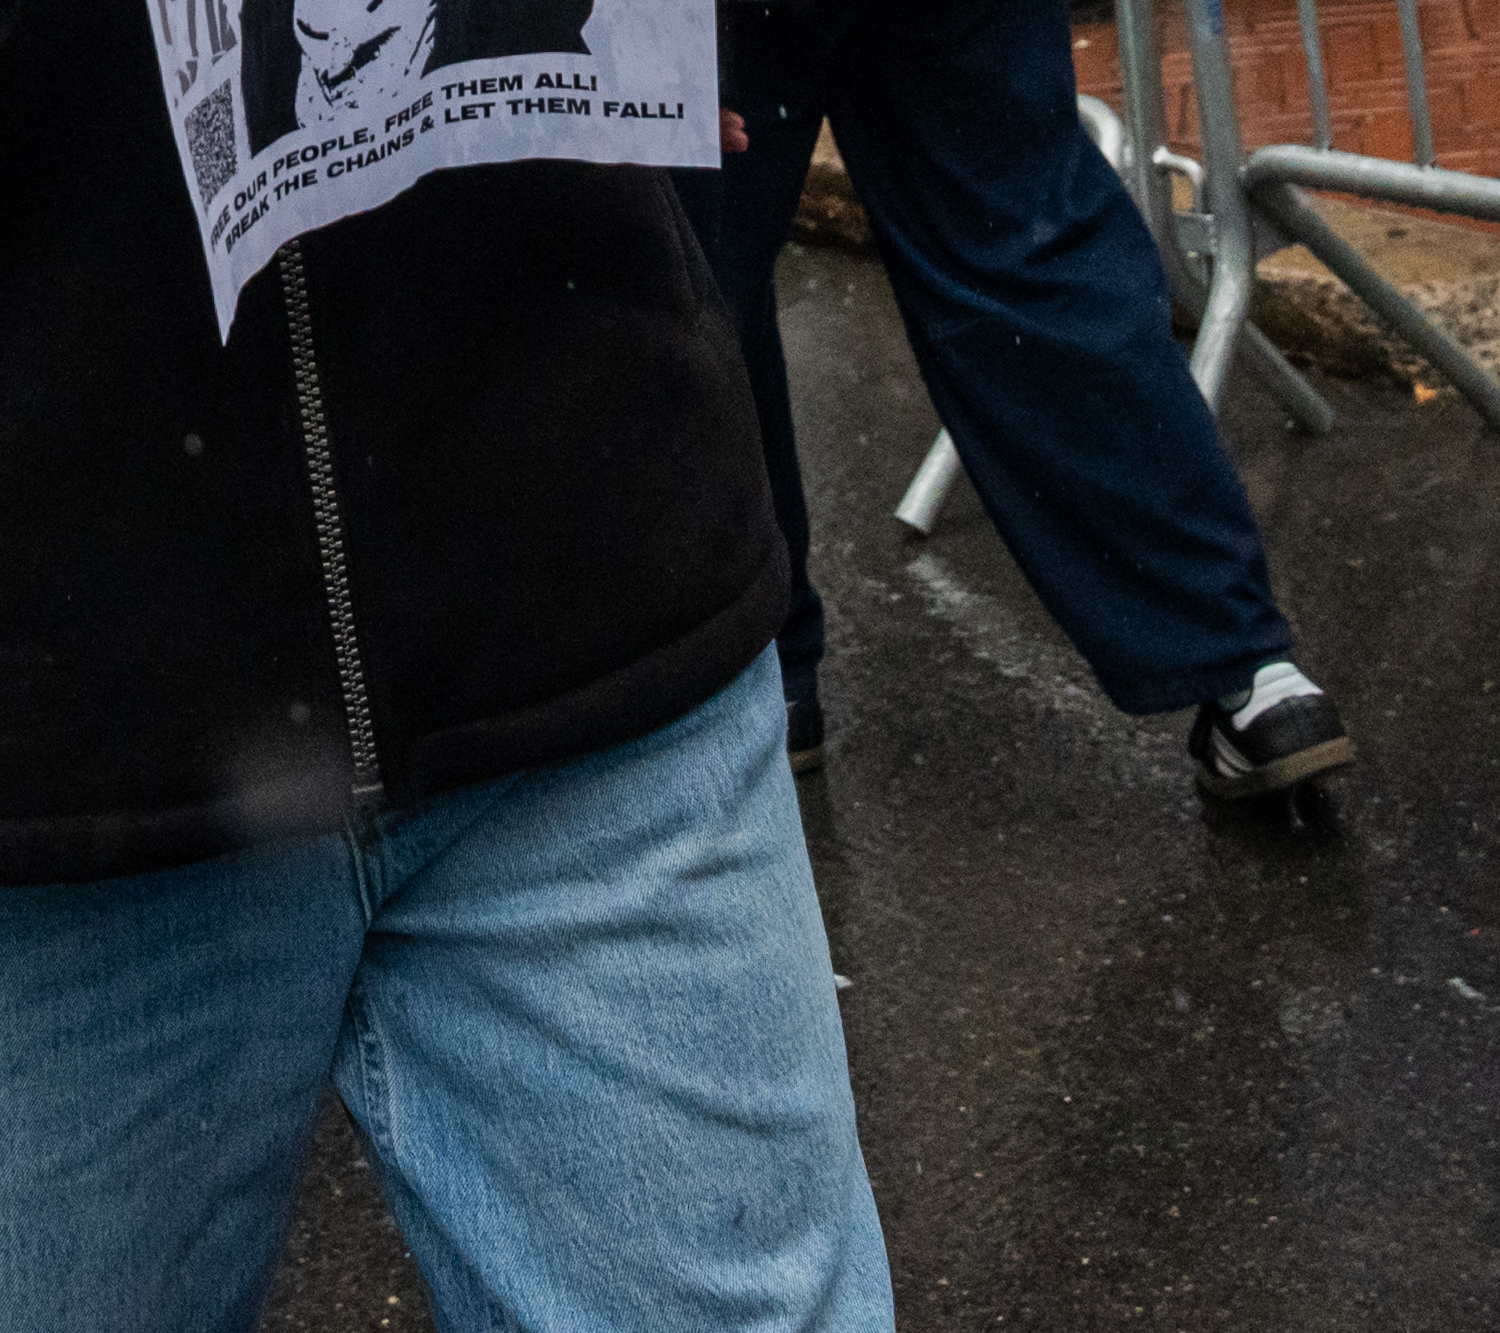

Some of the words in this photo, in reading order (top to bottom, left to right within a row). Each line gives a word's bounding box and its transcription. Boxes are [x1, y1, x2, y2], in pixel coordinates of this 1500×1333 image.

[210, 204, 231, 253] FREE
[233, 171, 267, 212] OUR
[273, 127, 375, 178] PEOPLE,
[384, 91, 433, 134] FREE
[441, 74, 523, 100] THEM
[535, 72, 598, 92] ALL!
[225, 194, 270, 254] BREAK
[273, 169, 318, 202] THE
[327, 128, 415, 178] CHAINS
[419, 115, 435, 133] &
[444, 101, 497, 124] LET
[506, 97, 591, 116] THEM
[603, 101, 685, 120] FALL!
